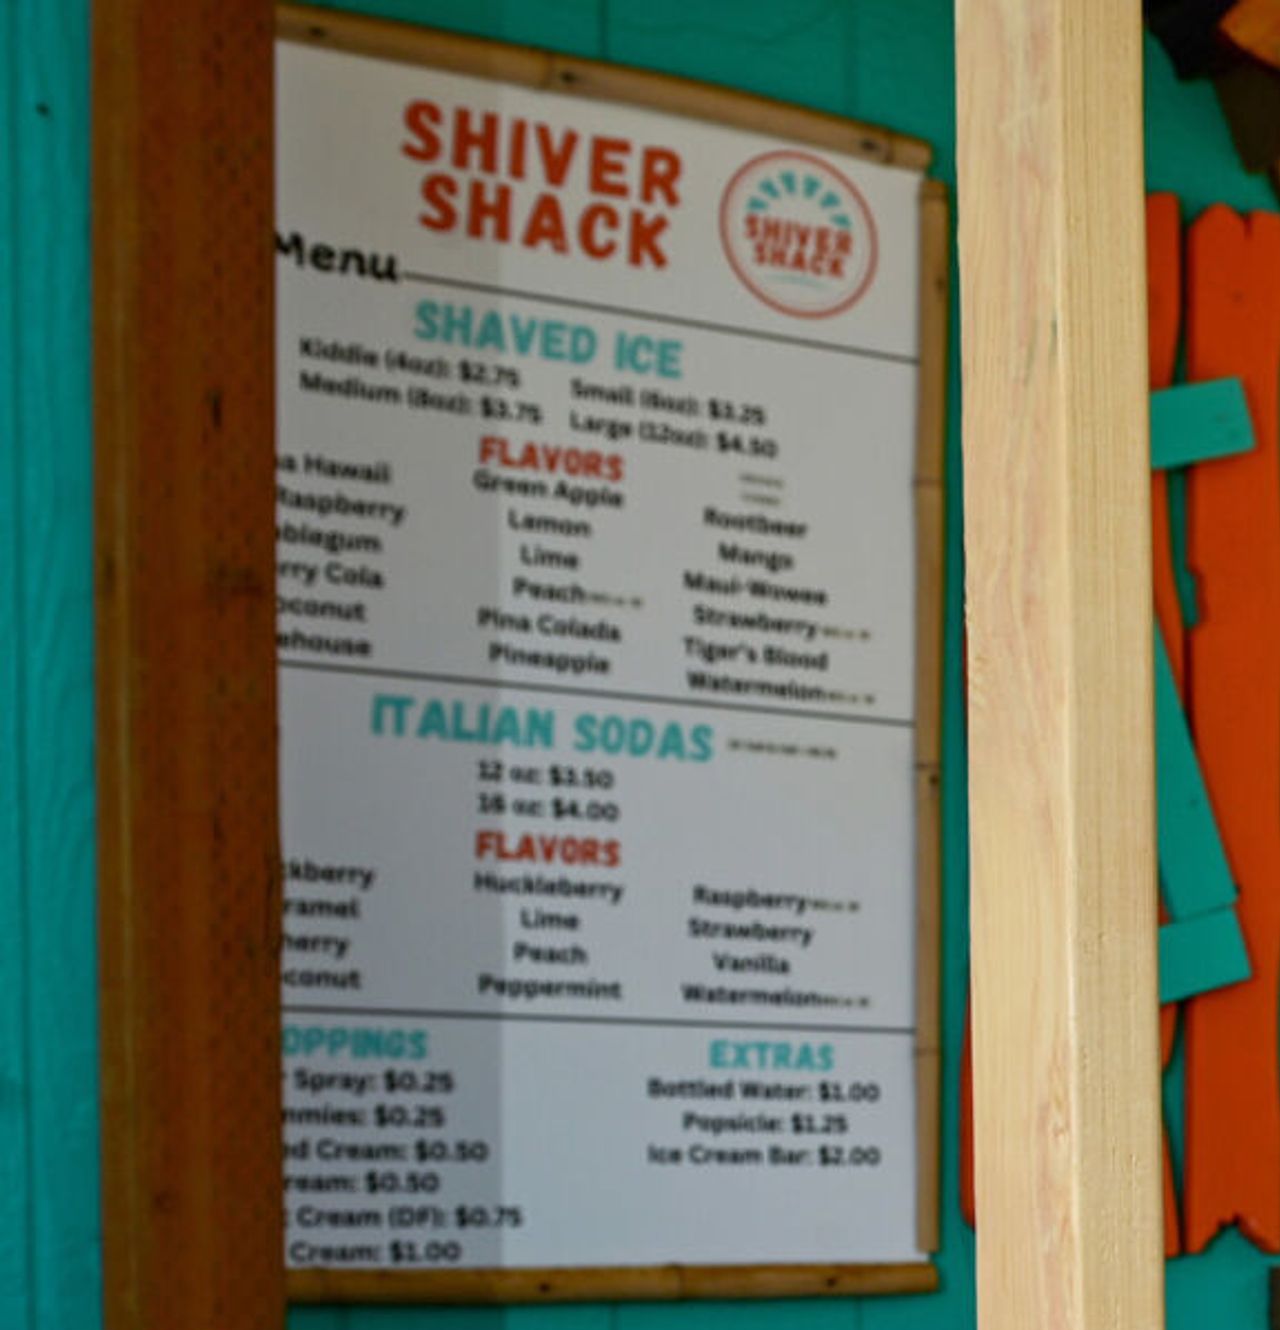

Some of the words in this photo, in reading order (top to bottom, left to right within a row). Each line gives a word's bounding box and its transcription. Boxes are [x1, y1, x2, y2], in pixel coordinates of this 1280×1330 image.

[401, 99, 683, 207] SHIVER
[419, 174, 669, 270] SHACK
[744, 213, 853, 257] SHIVER
[273, 230, 398, 283] Menu
[754, 241, 844, 279] SHACK
[414, 299, 597, 365] SHAVED
[614, 330, 683, 380] ICE
[299, 337, 379, 369] Kiddie
[459, 360, 521, 390] $2.75
[299, 370, 401, 404] Medium
[481, 396, 543, 426] $3.75
[570, 378, 634, 406] Small
[708, 399, 766, 426] $3.25
[570, 411, 632, 441] Large
[716, 431, 779, 460] $4.50
[304, 454, 391, 484] Hawaii
[479, 436, 624, 482] FLAVORS
[472, 468, 547, 498] Green
[554, 481, 625, 509] Apple
[507, 508, 592, 537] Lemon
[703, 506, 807, 540] Rootbeer
[520, 544, 580, 571] Lime
[718, 542, 794, 574] Mango
[324, 561, 385, 589] Cola
[513, 577, 585, 603] Peach
[477, 606, 531, 634] Pina
[536, 612, 622, 643] Colada
[693, 603, 817, 642] Strawberry
[489, 642, 611, 675] Pineapple
[683, 635, 757, 665] Tiger's
[764, 645, 829, 672] Blood
[687, 671, 828, 704] Watermelon
[371, 693, 555, 748] ITALIAN
[573, 714, 713, 762] SODAS
[477, 760, 502, 783] 12
[549, 761, 614, 790] $3.50
[478, 793, 506, 815] 16
[553, 795, 619, 823] $4.00
[474, 829, 620, 867] FLAVORS
[283, 858, 374, 889] kberry
[474, 871, 623, 904] Huckleberry
[693, 885, 806, 915] Raspberry
[520, 909, 580, 930] Lime
[688, 917, 814, 947] Strawberry
[513, 942, 588, 966] Peach
[713, 952, 790, 974] Vanilla
[478, 973, 622, 1001] Peppermint
[682, 983, 819, 1007] Watermelon
[709, 1039, 835, 1073] EXTRAS
[294, 1069, 375, 1096] Spray:
[384, 1069, 455, 1095] $0.25
[647, 1077, 733, 1100] Bottled
[740, 1080, 811, 1102] Water:
[819, 1081, 881, 1104] $1.00
[375, 1103, 446, 1129] $0.25
[682, 1111, 781, 1137] Popsicle:
[792, 1112, 849, 1135] $1.25
[317, 1139, 406, 1161] Cream:
[416, 1138, 490, 1163] $0.50
[648, 1144, 681, 1165] Ice
[689, 1145, 762, 1166] Cream
[769, 1145, 812, 1167] Bar:
[819, 1145, 882, 1168] $2.00
[365, 1171, 440, 1195] $0.50
[296, 1206, 381, 1228] Cream
[456, 1206, 523, 1230] $0.75
[289, 1241, 378, 1263] Cream:
[390, 1241, 462, 1265] $1.00
